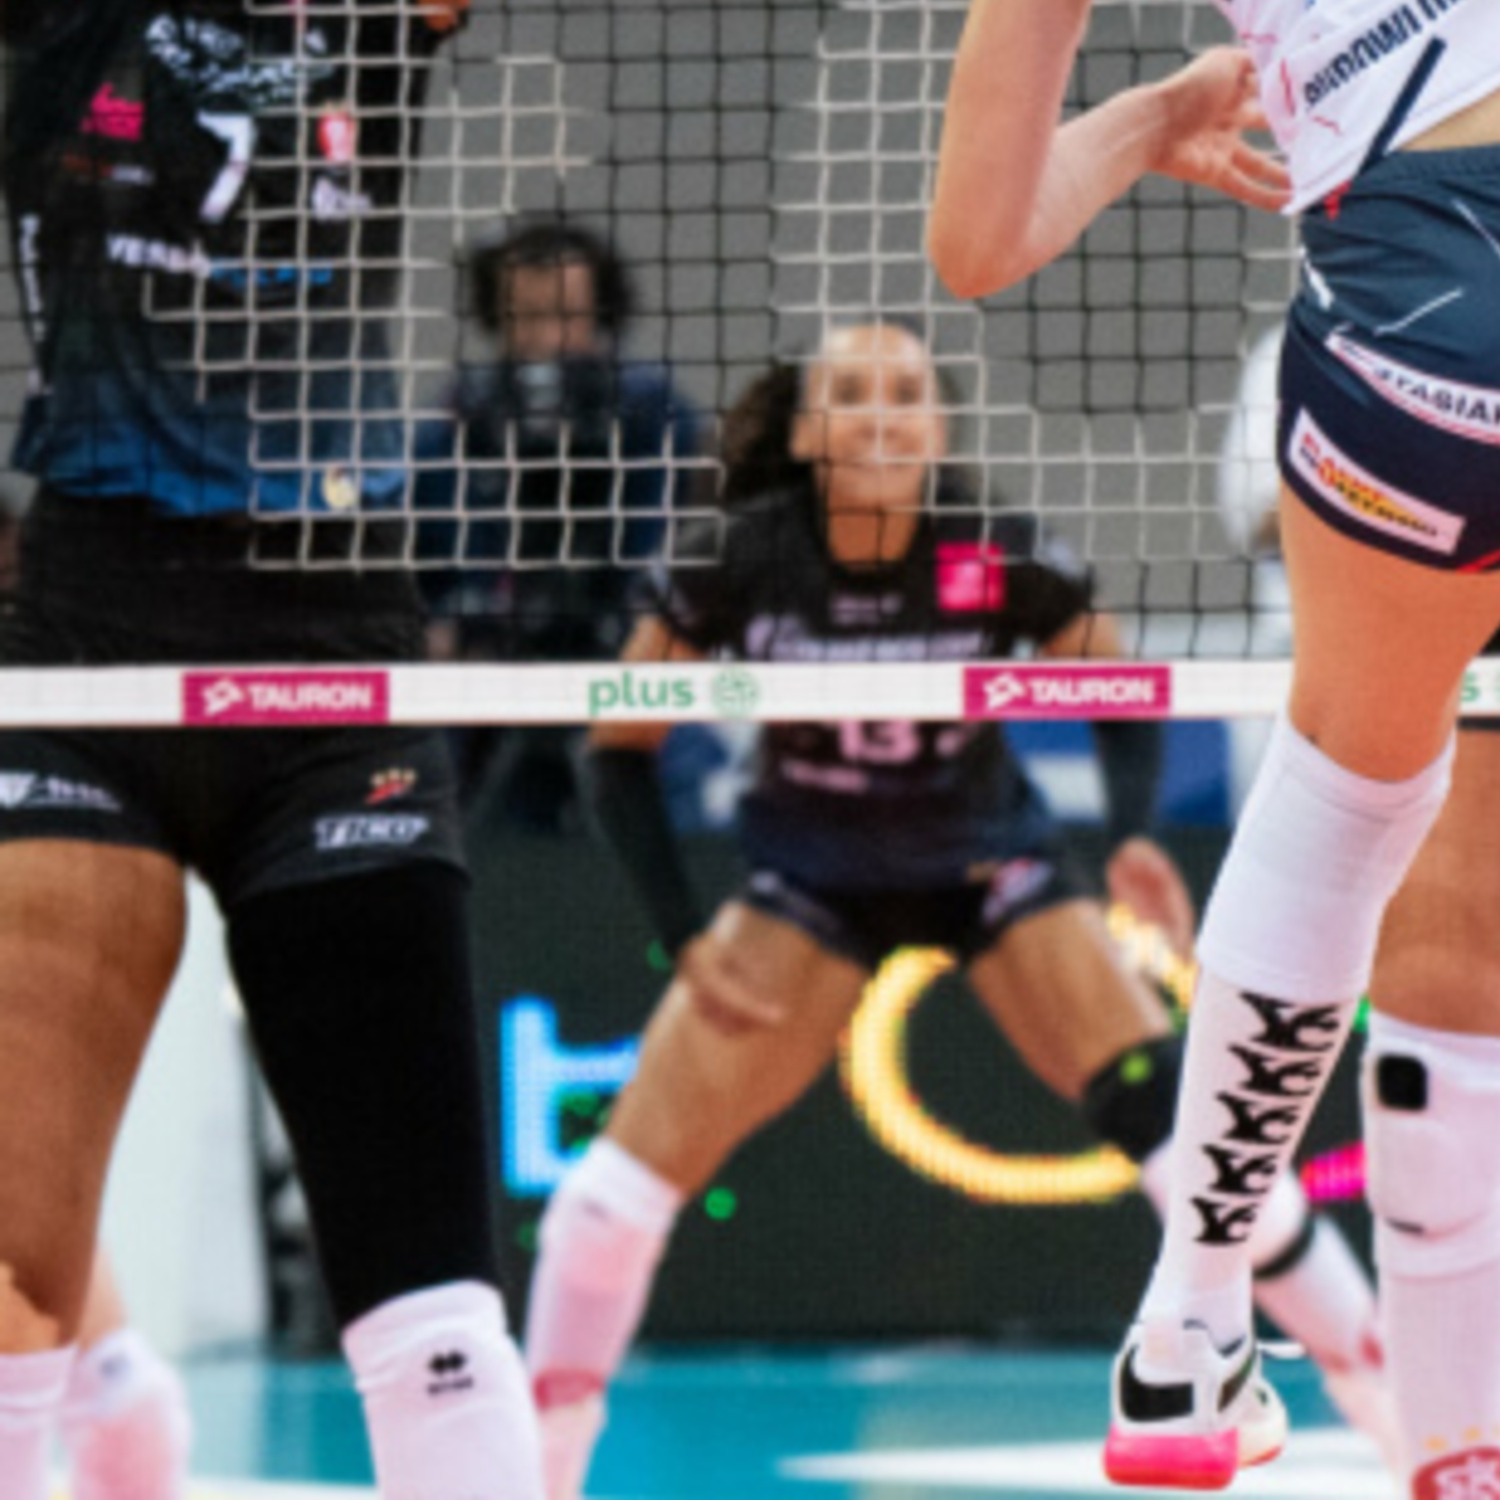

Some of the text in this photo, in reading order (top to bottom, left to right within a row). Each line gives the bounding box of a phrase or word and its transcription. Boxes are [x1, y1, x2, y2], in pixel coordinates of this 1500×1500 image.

[197, 111, 255, 222] 7
[248, 683, 373, 712] TAURON
[588, 666, 695, 714] plus
[1030, 676, 1155, 704] TAURON
